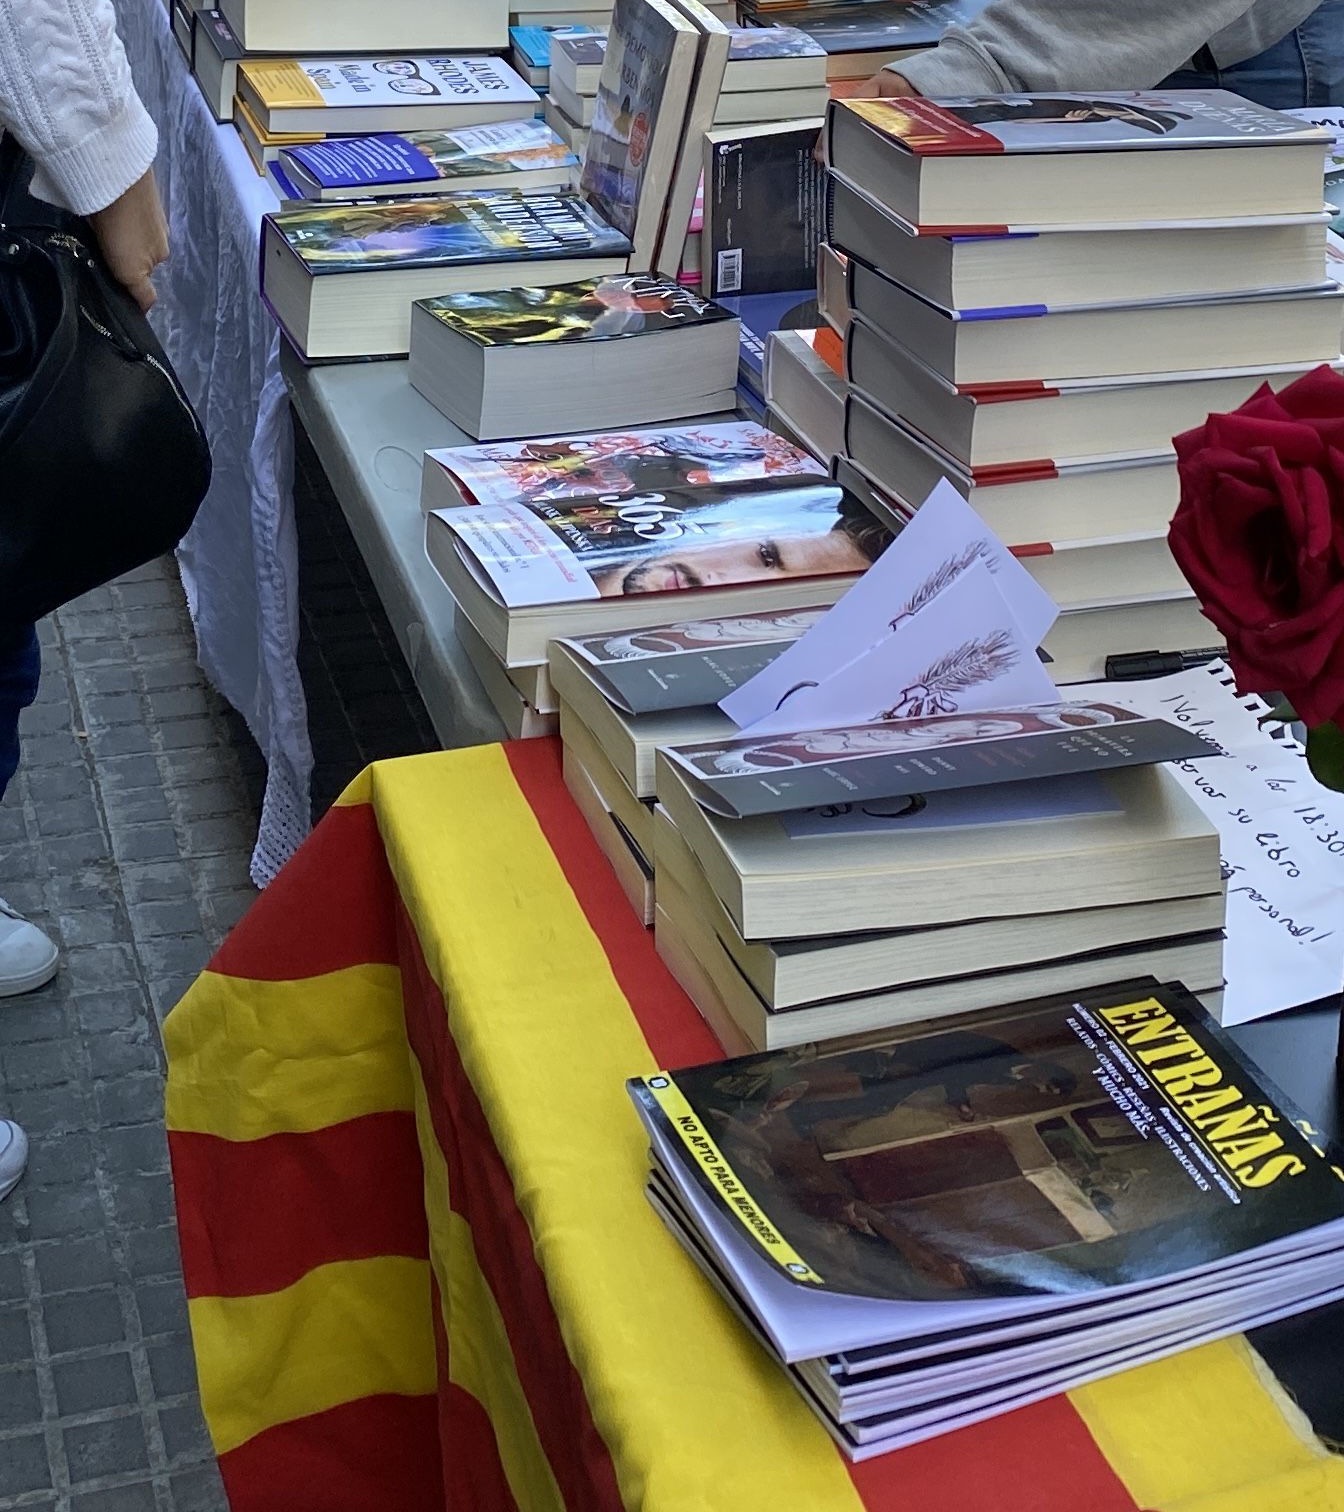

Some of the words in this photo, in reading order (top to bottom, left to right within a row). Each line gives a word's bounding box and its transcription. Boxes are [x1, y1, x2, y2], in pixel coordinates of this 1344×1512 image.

[306, 67, 343, 91] Spain
[334, 64, 372, 83] Made
[426, 58, 479, 95] RHODES
[463, 60, 509, 92] JAMES
[1228, 807, 1254, 825] su
[1256, 832, 1302, 879] libro
[1227, 885, 1336, 946] personal!
[1105, 1039, 1138, 1075] FEBRERO
[1132, 1070, 1152, 1091] 2021
[1064, 1016, 1098, 1052] RELATOS
[1095, 1050, 1126, 1085] CÓMICS
[1122, 1085, 1156, 1124] RESEÑAS
[1154, 1123, 1213, 1193] ILUSTRACIONES
[1097, 1072, 1135, 1115] MUCHO
[1098, 996, 1308, 1190] ENTRAÑAS
[677, 1114, 699, 1133] NO
[689, 1134, 719, 1165] APTO
[710, 1165, 740, 1196] PARA
[731, 1194, 782, 1247] MENORES
